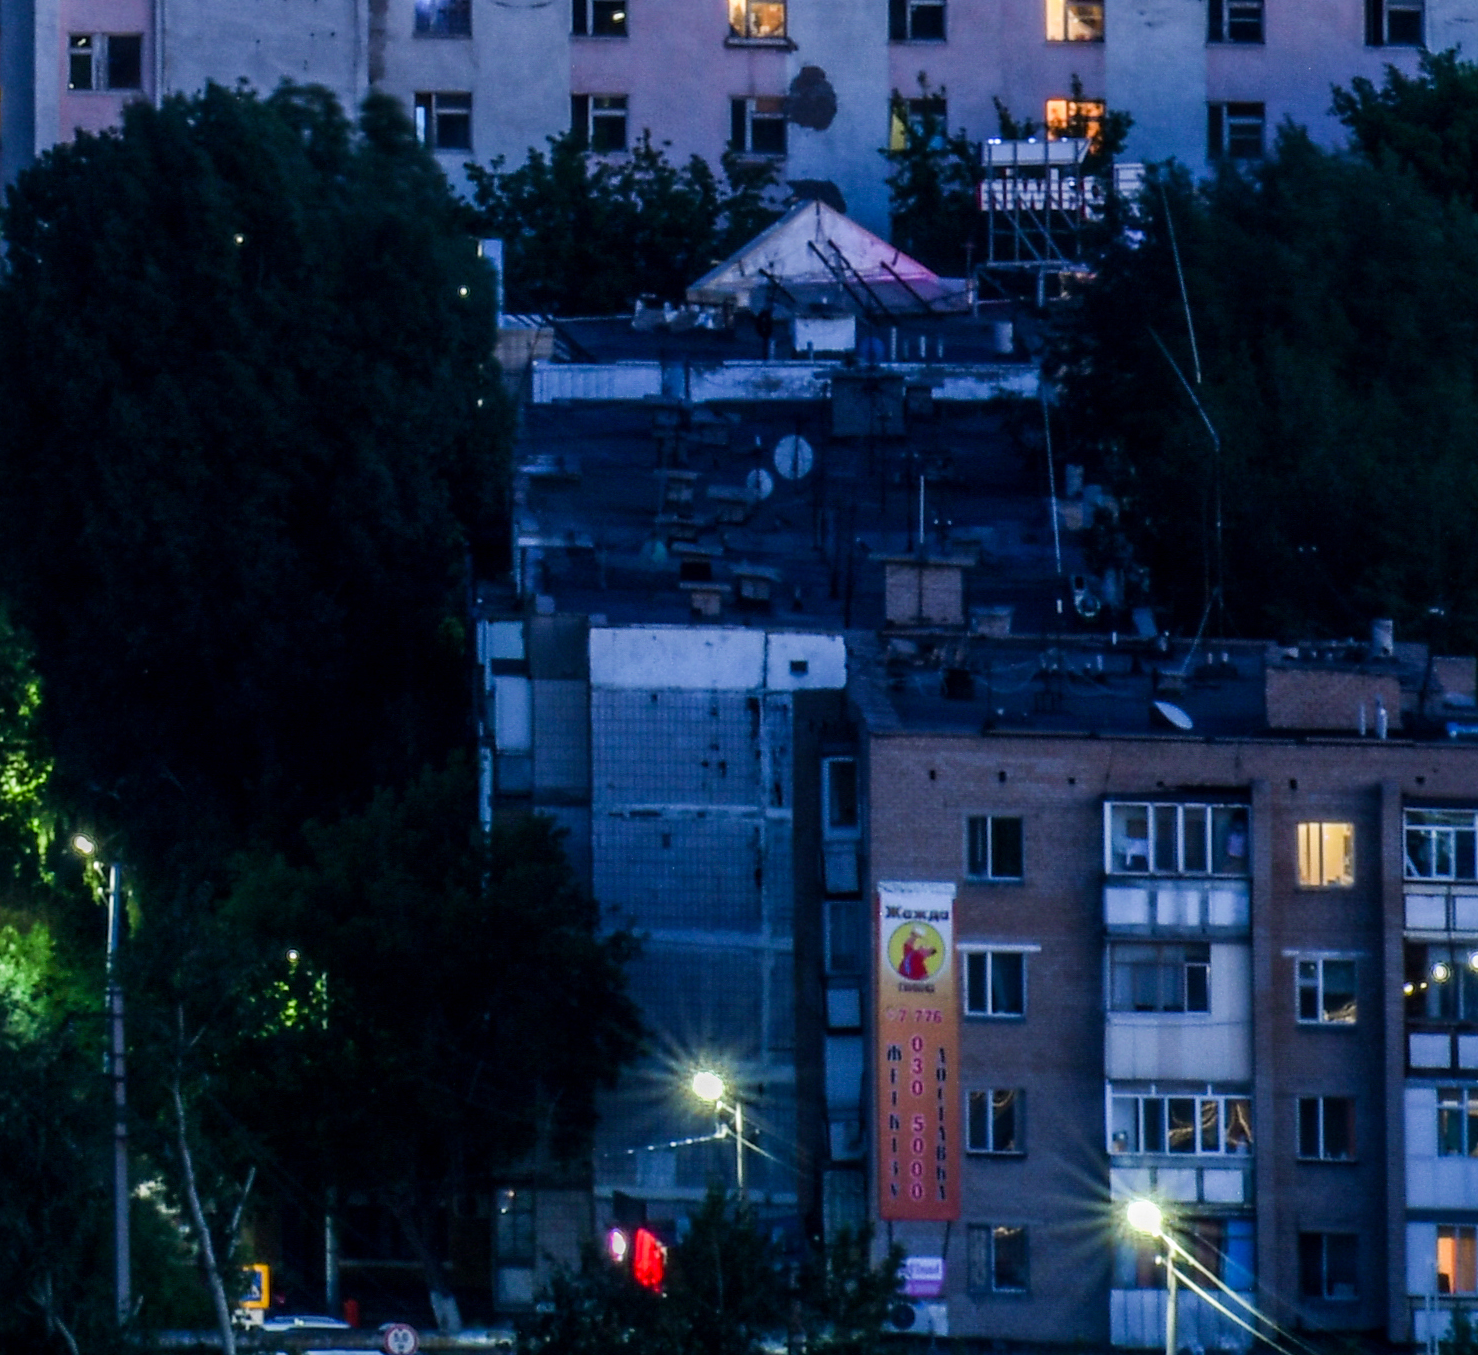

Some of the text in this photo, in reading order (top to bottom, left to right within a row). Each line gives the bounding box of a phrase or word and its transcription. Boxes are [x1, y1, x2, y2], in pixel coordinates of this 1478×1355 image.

[885, 905, 949, 922] Жажда
[915, 1009, 942, 1025] 776
[911, 1036, 924, 1200] 030 5000
